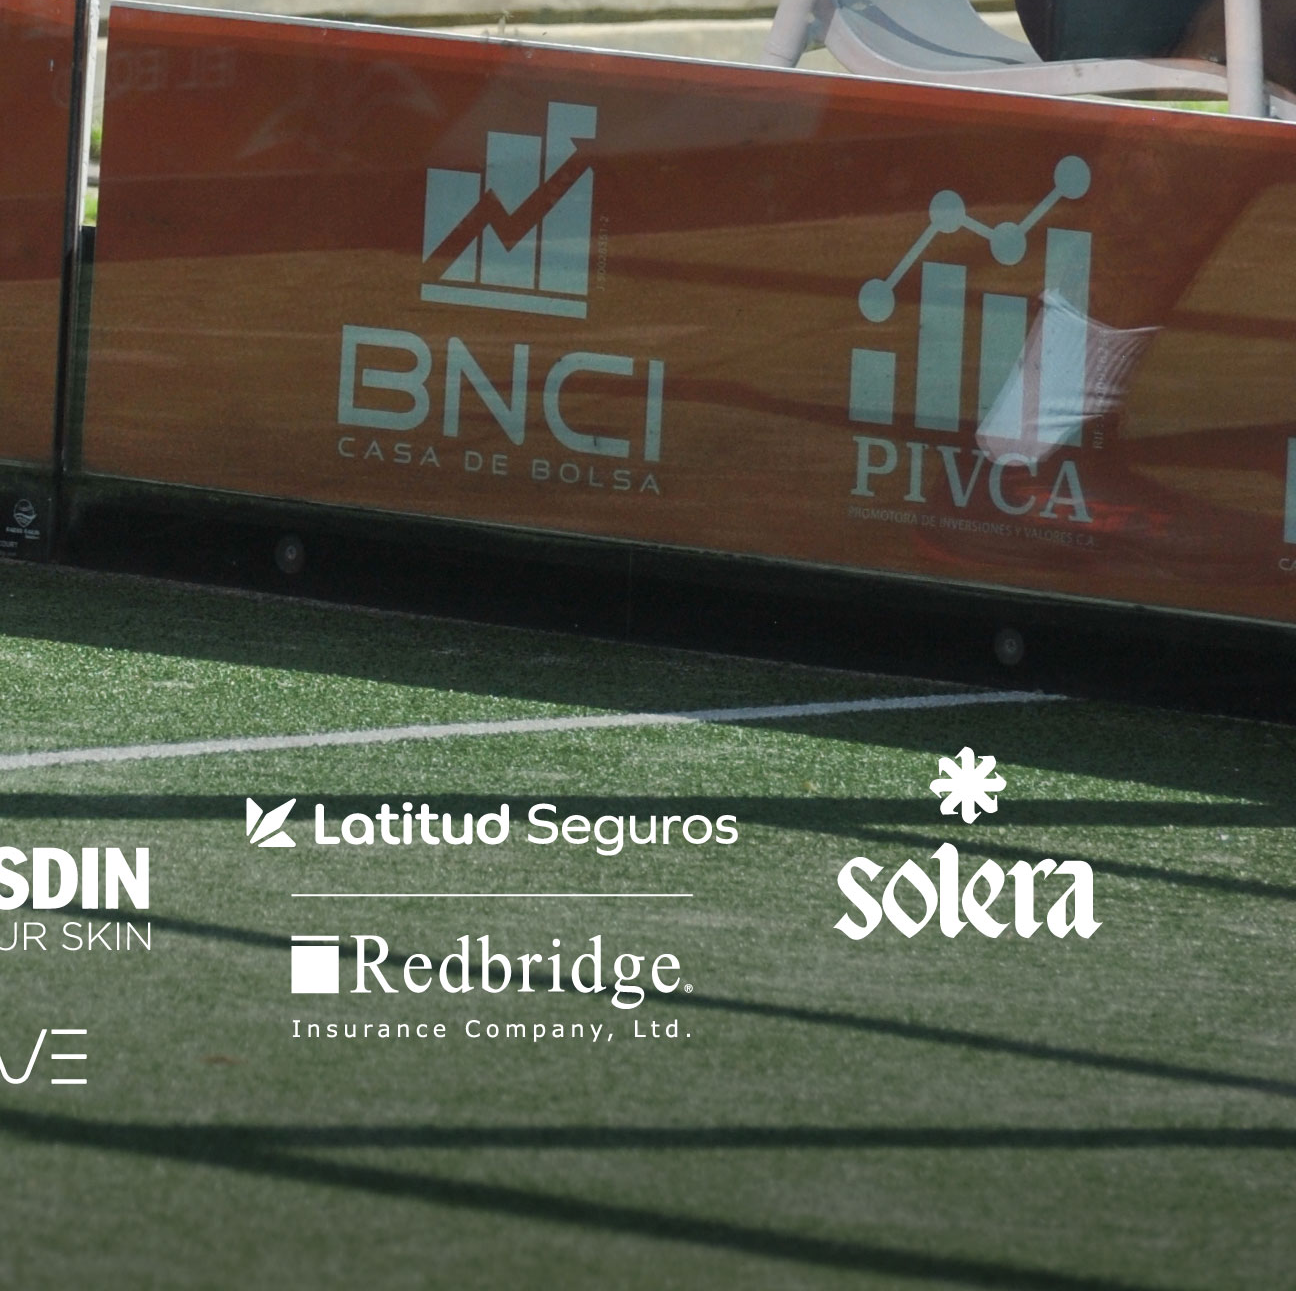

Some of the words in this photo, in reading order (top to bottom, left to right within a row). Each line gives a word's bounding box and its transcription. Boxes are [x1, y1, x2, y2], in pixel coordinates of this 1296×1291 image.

[337, 323, 665, 462] BNCI
[338, 436, 441, 468] CASA
[464, 451, 509, 476] DE
[531, 459, 661, 495] BOLSA
[849, 435, 1094, 524] PIVCA
[847, 505, 919, 525] PROMOTORA
[920, 514, 937, 528] DE
[939, 516, 1013, 537] INVERSIONES
[1024, 527, 1073, 543] VALORES
